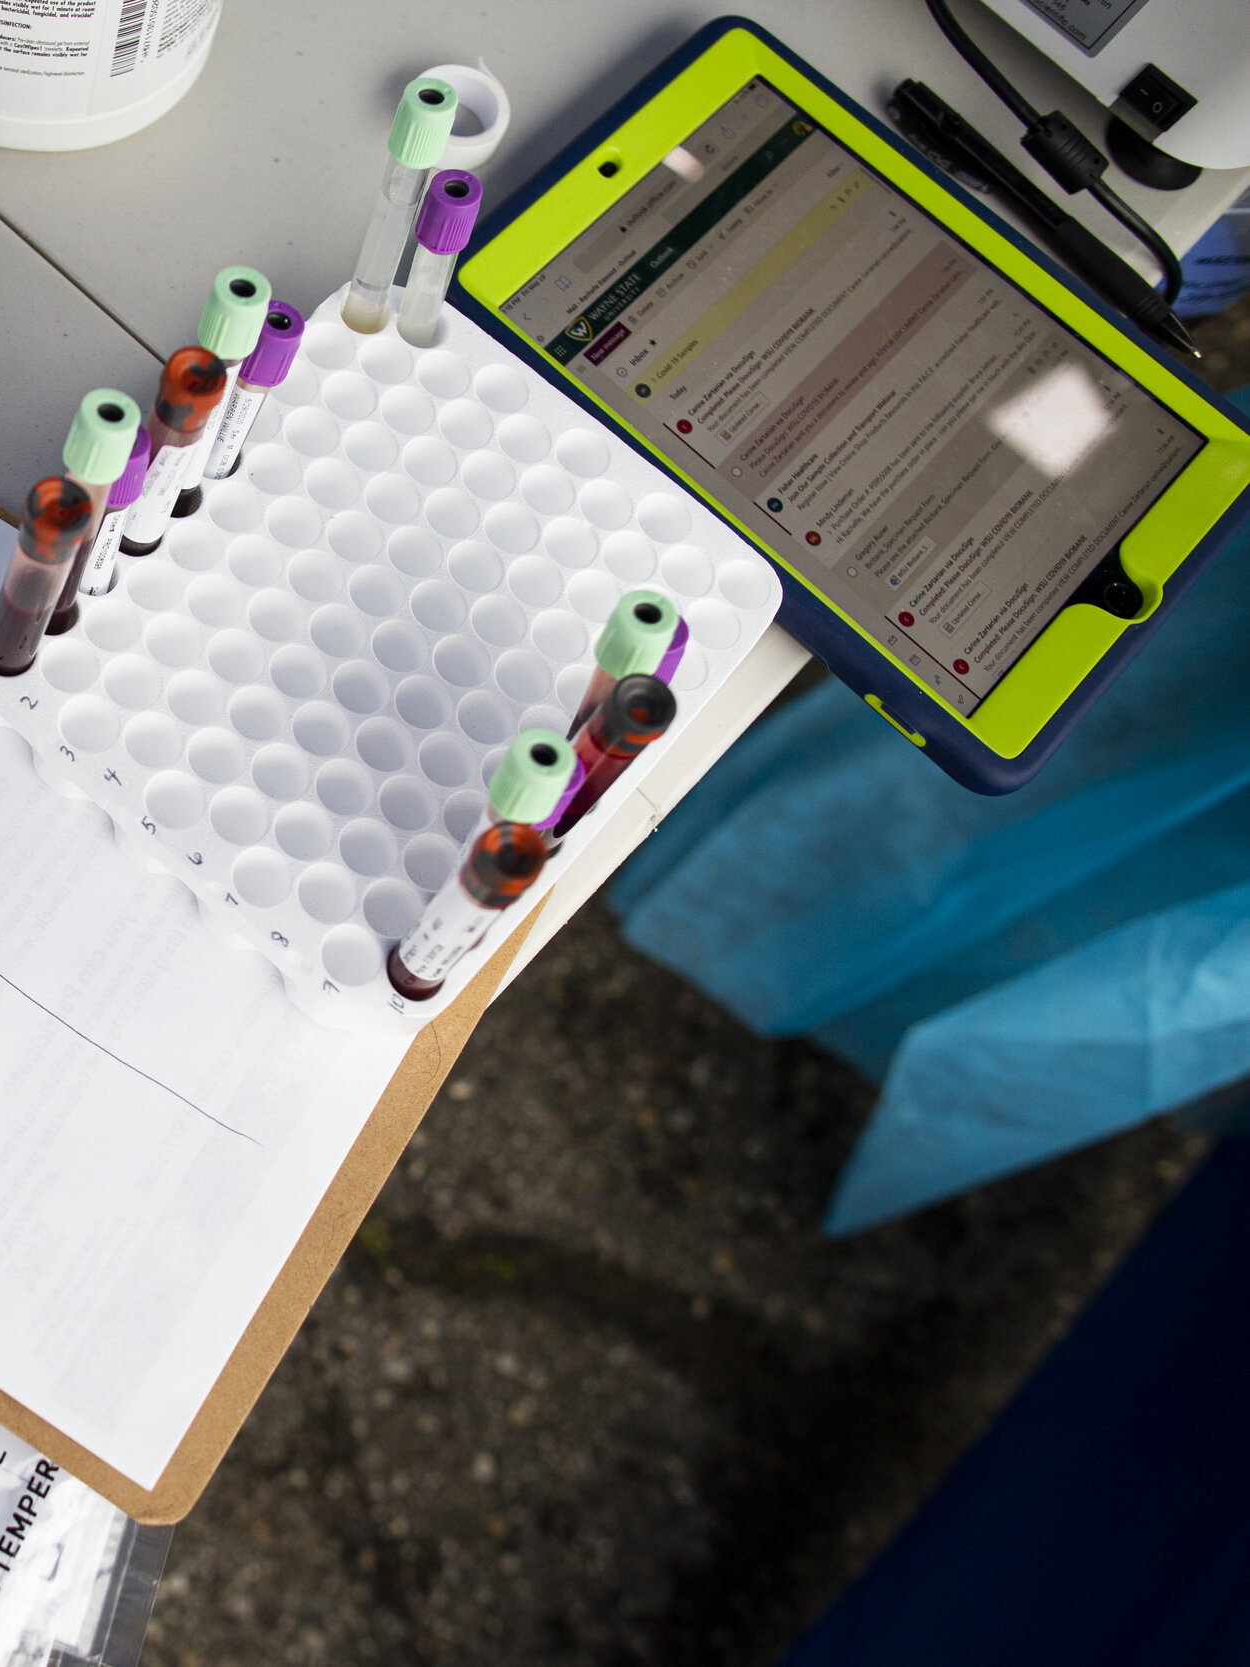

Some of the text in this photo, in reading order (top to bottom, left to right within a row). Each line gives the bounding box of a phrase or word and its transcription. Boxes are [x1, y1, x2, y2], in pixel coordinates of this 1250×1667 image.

[648, 244, 675, 269] Outlook
[587, 271, 641, 321] WAYNE STATE
[602, 285, 641, 321] UNIVERSITY
[628, 346, 649, 366] Inbox
[669, 383, 688, 401] Today
[777, 451, 819, 494] Fisher Healthcare
[815, 509, 835, 529] Mindy
[942, 568, 962, 589] Please
[979, 532, 994, 548] WSU
[990, 511, 1014, 536] COVID19
[1009, 487, 1034, 514] BIOBANK
[908, 535, 976, 608] Carine Zartarian via DocuSign
[997, 615, 1016, 635] Please
[1033, 578, 1049, 594] WSU
[1044, 556, 1068, 581] COVID19
[1063, 533, 1088, 560] BIOBANK
[962, 581, 1030, 655] Carine Zartarian via DocuSign
[20, 696, 38, 710] 2
[60, 745, 76, 762] 3
[103, 767, 122, 787] 4
[141, 816, 157, 835] 5
[187, 851, 204, 866] 6
[225, 892, 240, 908] 7
[271, 931, 289, 947] 8
